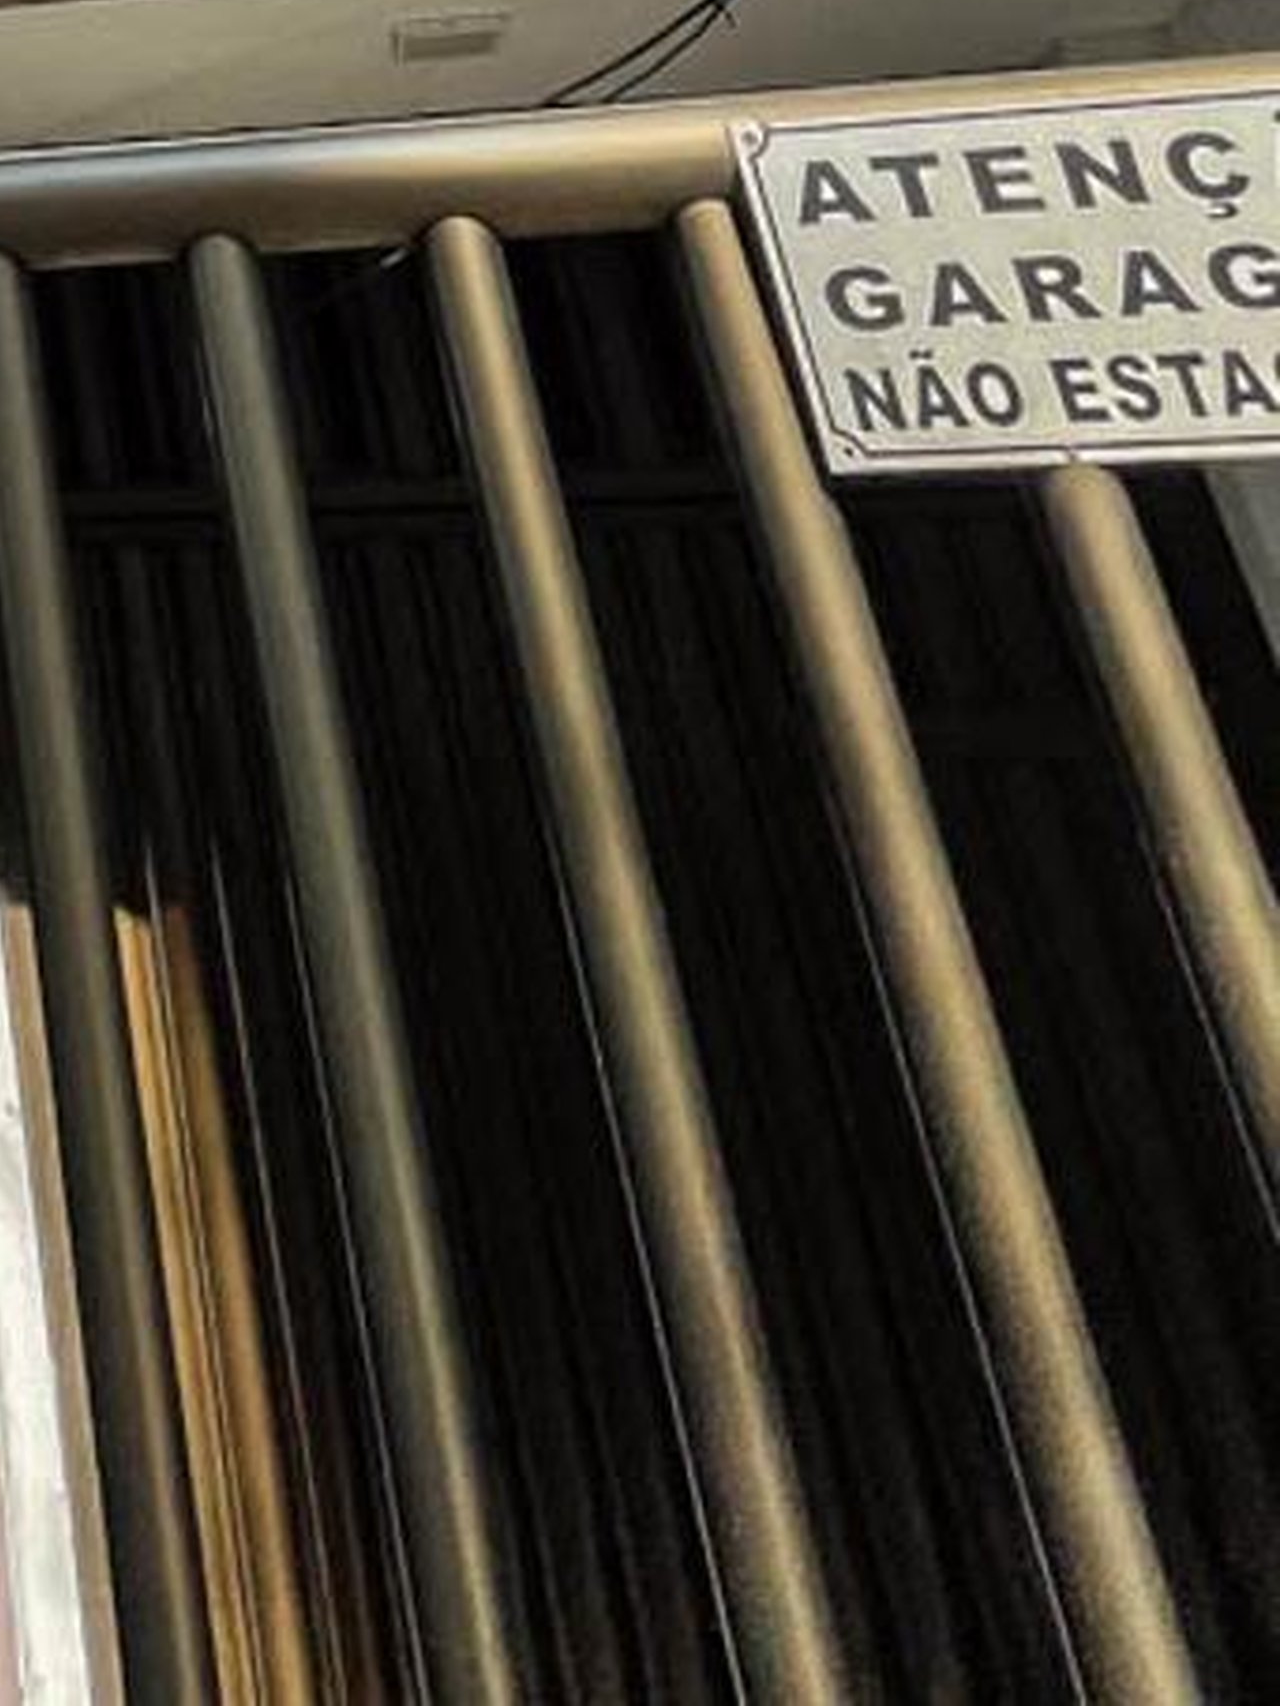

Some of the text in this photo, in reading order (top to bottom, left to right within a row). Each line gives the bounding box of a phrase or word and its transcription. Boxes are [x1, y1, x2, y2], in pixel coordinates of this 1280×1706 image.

[823, 242, 1280, 333] GARAG
[843, 349, 1280, 432] NÃO ESTA
